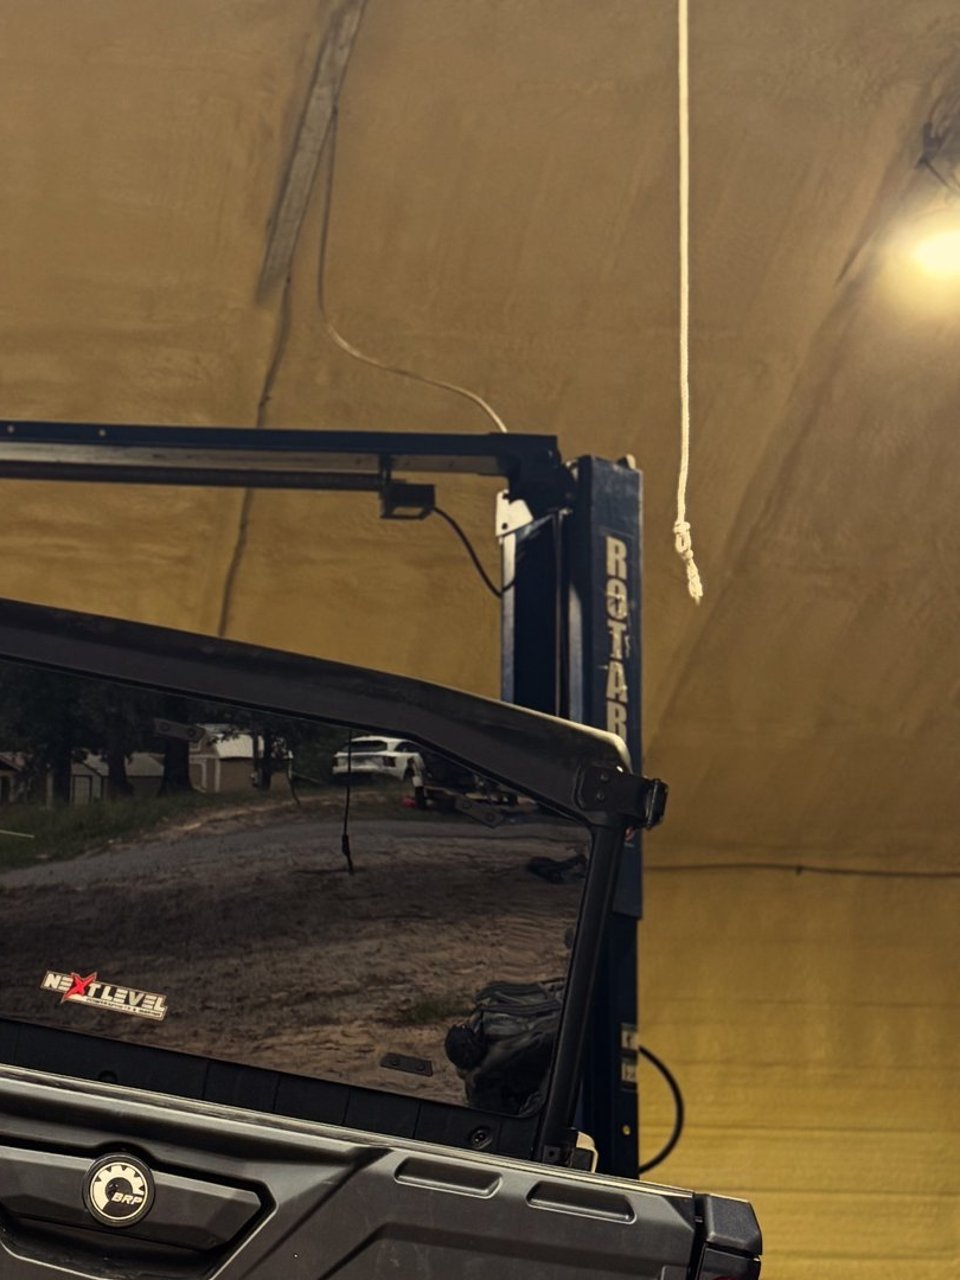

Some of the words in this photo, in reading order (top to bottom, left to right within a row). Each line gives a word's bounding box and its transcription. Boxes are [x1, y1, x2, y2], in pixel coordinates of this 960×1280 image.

[605, 536, 628, 740] ROTAR
[43, 971, 98, 1003] NEXT
[100, 985, 167, 1012] LEVEL
[111, 1192, 143, 1205] BRP
